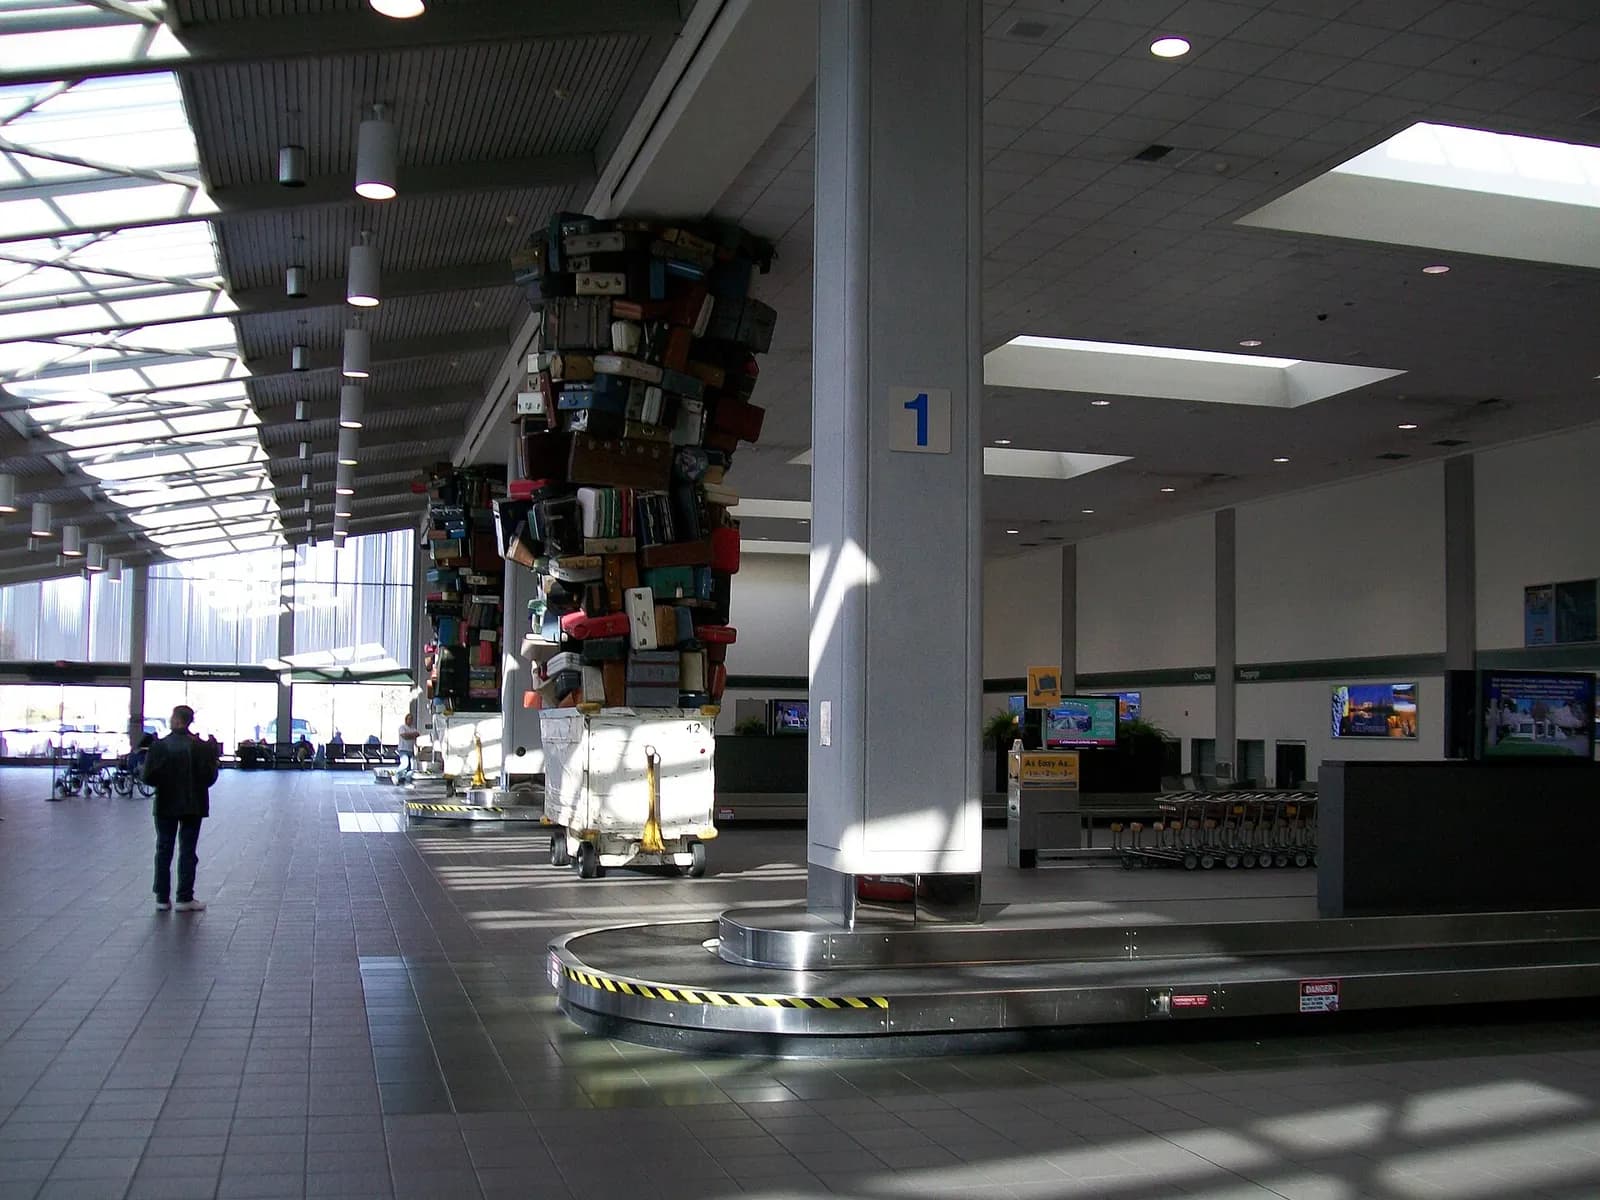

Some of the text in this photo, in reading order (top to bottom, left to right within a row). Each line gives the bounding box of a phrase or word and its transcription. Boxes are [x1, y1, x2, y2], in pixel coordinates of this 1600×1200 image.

[904, 393, 928, 446] 1
[1038, 760, 1056, 769] Easy
[1305, 985, 1334, 993] DANGER
